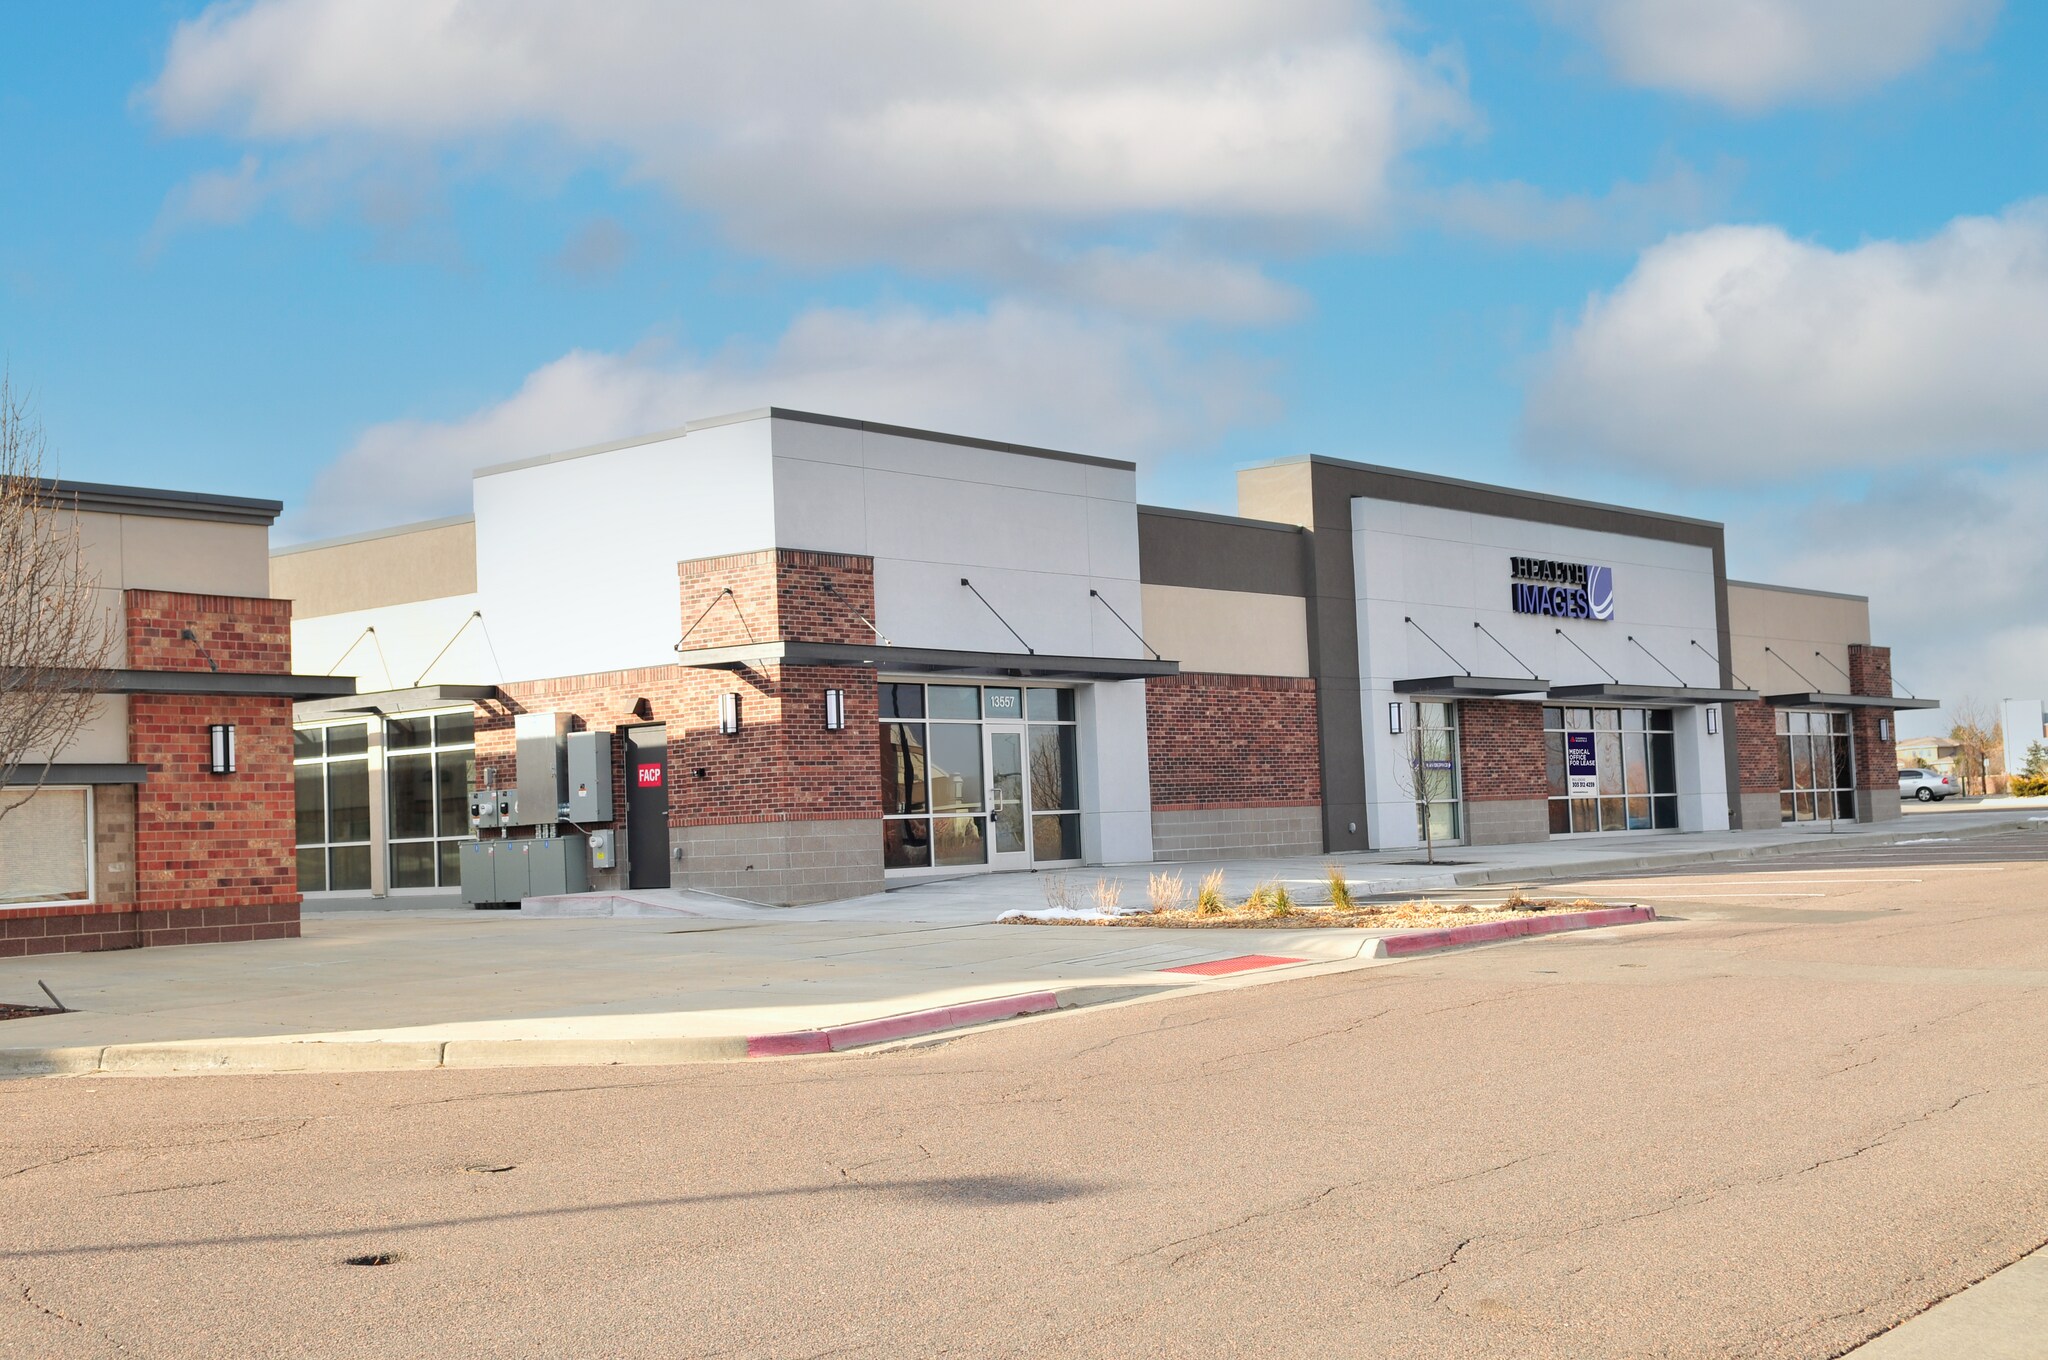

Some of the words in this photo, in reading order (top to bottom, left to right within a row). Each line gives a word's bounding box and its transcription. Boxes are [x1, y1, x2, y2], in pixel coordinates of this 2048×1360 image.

[1510, 556, 1587, 585] HEALTH
[1511, 583, 1589, 619] IMAGES
[990, 696, 1015, 708] 13557
[639, 768, 661, 782] FACP
